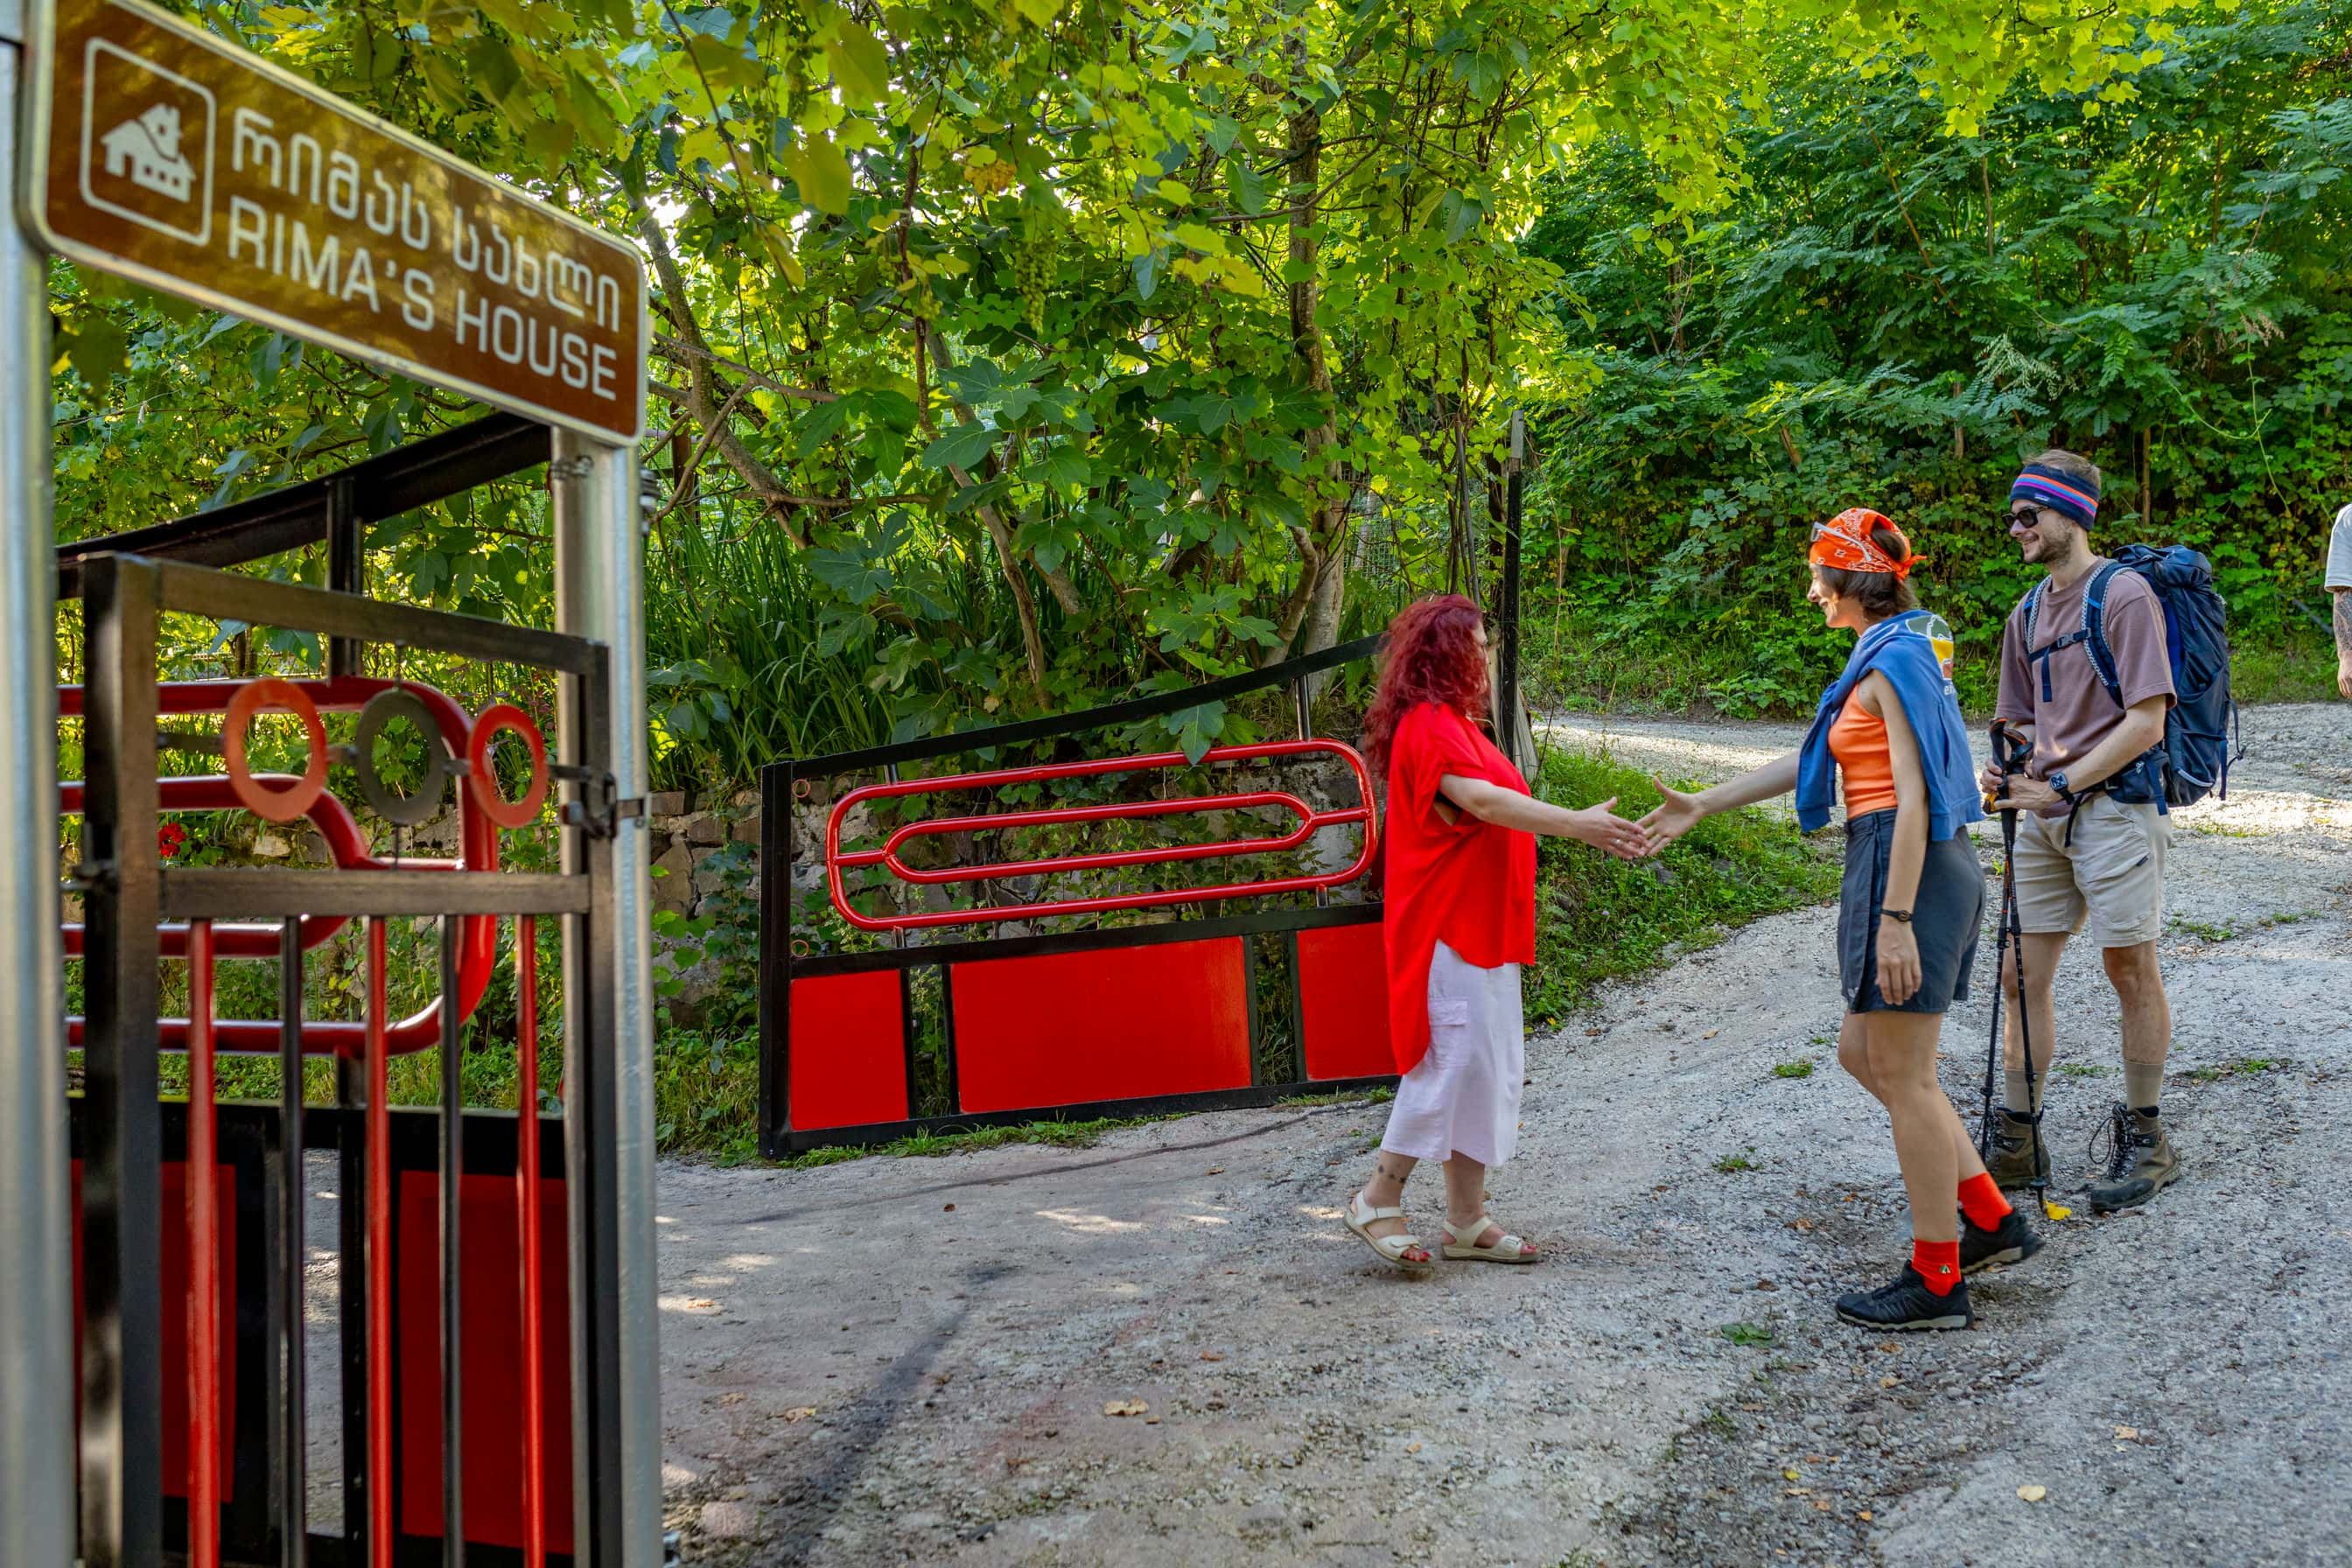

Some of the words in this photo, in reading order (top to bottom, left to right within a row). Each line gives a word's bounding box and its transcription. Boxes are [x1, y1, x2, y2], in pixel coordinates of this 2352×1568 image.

[228, 195, 435, 331] RIMA'S
[456, 288, 616, 401] HOUSE
[232, 107, 430, 250] რიმას
[453, 206, 620, 332] სახლი
